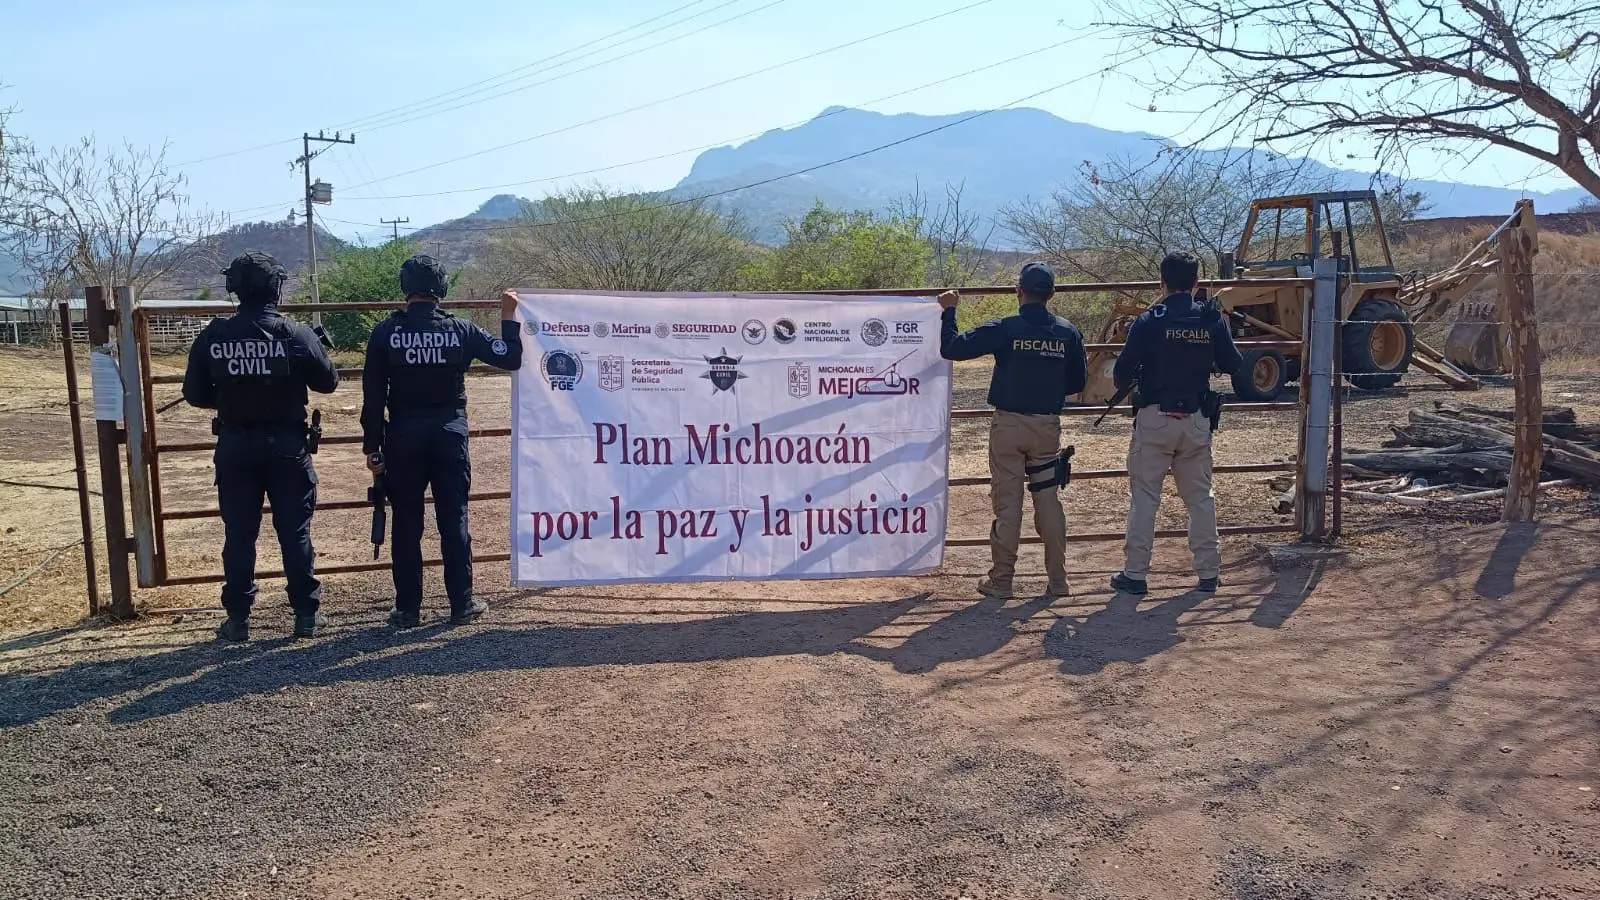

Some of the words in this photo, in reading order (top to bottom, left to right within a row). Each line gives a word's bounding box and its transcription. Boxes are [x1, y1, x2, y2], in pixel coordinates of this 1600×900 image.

[542, 322, 590, 333] Defensa
[612, 323, 651, 334] Marina
[672, 324, 737, 334] SEGURIDAD
[895, 322, 919, 334] FGR
[389, 330, 461, 348] GUARDIA
[210, 340, 286, 359] GUARDIA
[1013, 339, 1065, 353] FISCALÍA
[405, 348, 447, 365] CIVIL
[228, 358, 271, 376] CIVIL
[643, 367, 684, 376] Seguridad
[818, 366, 864, 374] MICHOACÁN
[551, 380, 574, 391] FGE
[593, 422, 673, 465] Plan
[684, 422, 871, 466] Michoacán
[530, 510, 598, 557] por
[609, 496, 644, 540] la
[655, 509, 718, 554] paz
[729, 509, 750, 553] y
[761, 494, 792, 537] la
[800, 493, 928, 551] justicia
